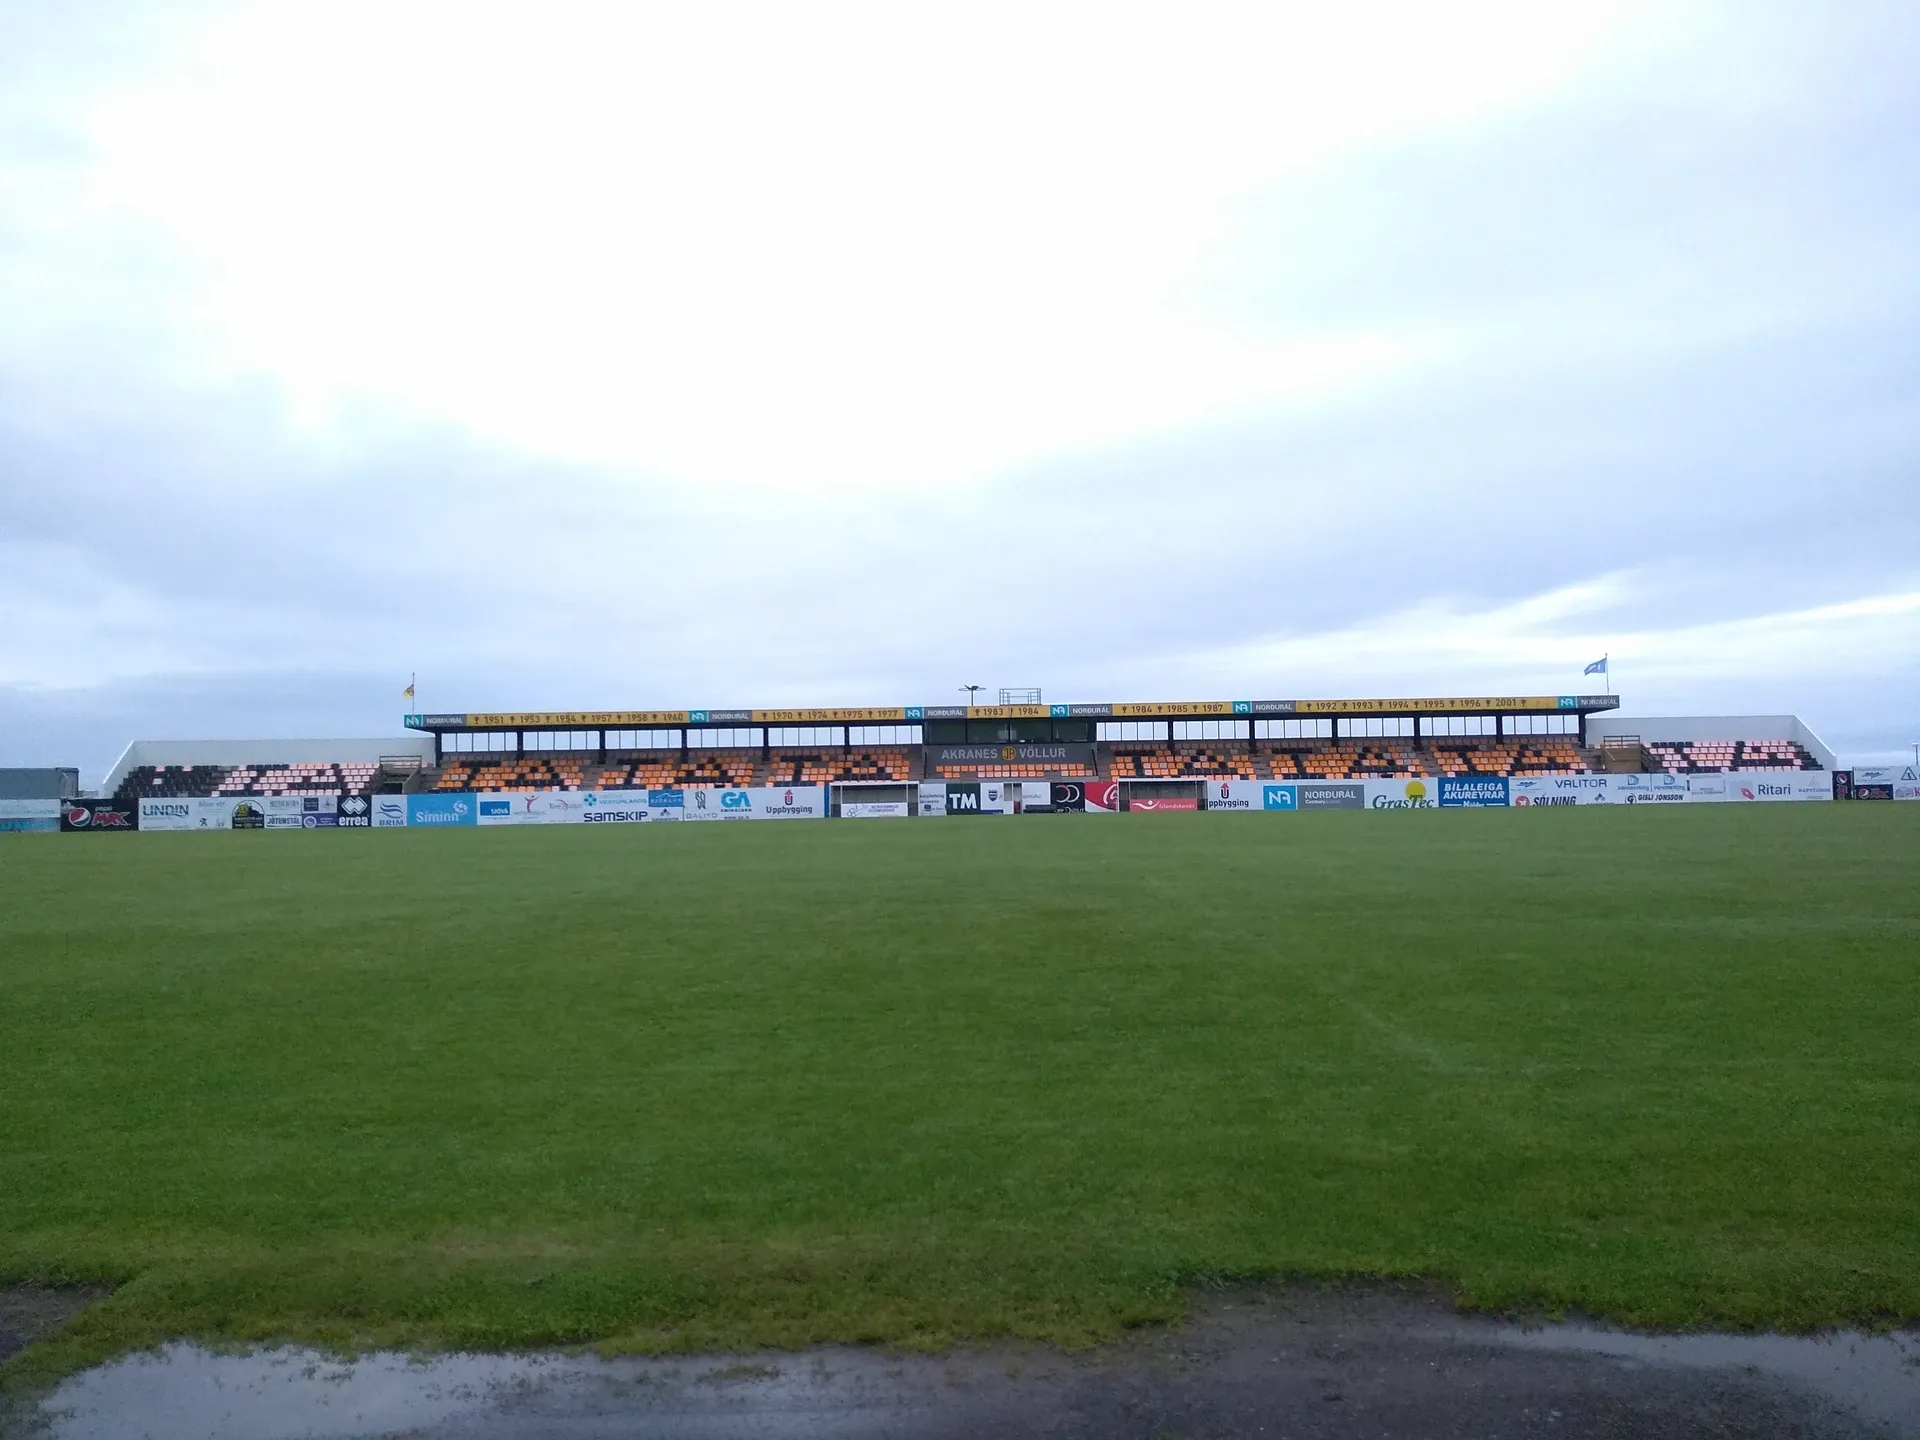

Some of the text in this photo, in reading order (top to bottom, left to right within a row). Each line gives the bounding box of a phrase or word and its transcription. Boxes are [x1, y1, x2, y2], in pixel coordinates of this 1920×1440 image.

[1131, 704, 1223, 713] 1984 1985 1987
[1316, 699, 1517, 710] 1992 1993 1994 1995 1996 2001
[772, 710, 898, 720] 1970 1974 1975 1977
[983, 707, 1039, 716] 1983 1984
[484, 713, 683, 724] 1951 1953 1954 1957 1958 1960
[941, 748, 998, 760] AKRANES
[1019, 746, 1066, 758] VÖLLUR
[1444, 782, 1503, 792] BÍLALEIGA
[1555, 778, 1607, 788] VALITOR
[1758, 784, 1791, 795] Ritari
[721, 791, 752, 808] GA
[949, 793, 978, 809] TM
[1443, 791, 1505, 800] AKUREYRAR
[766, 805, 813, 816] Uppbygging
[416, 810, 459, 823] Síminn
